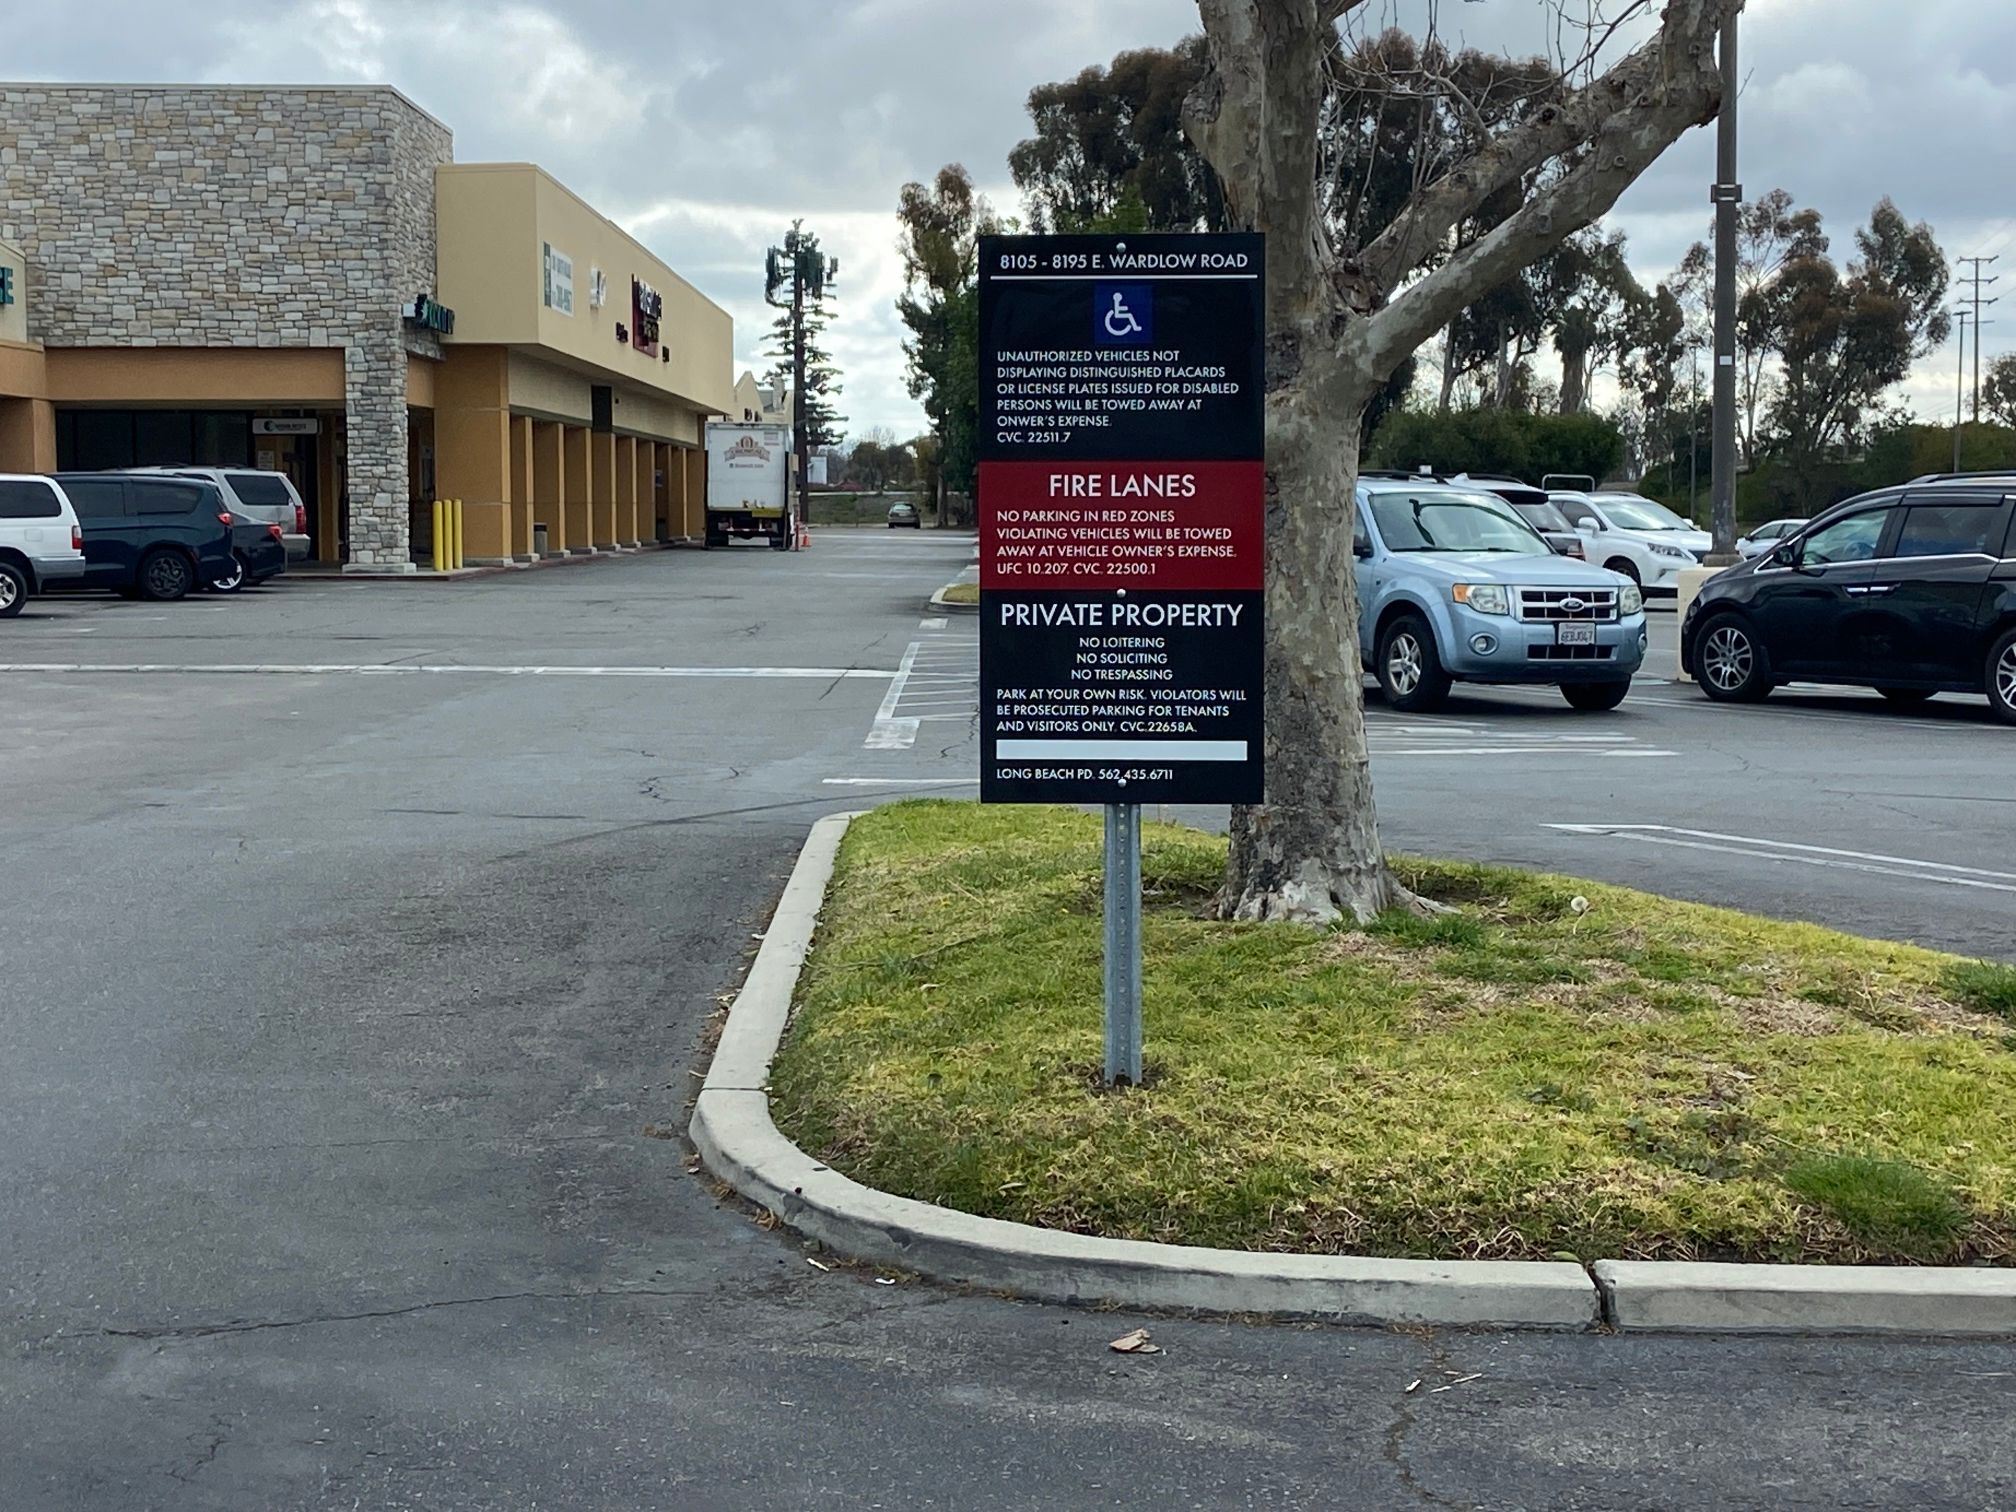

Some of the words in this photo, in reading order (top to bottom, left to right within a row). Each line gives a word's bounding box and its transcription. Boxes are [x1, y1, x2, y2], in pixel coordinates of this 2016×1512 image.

[1000, 254, 1037, 269] 8105
[1052, 254, 1087, 269] 8195
[1092, 254, 1105, 269] E.
[1109, 254, 1197, 268] WARDLOW
[1201, 253, 1248, 268] ROAD
[997, 350, 1092, 362] UNAUTHORIZED
[1095, 350, 1150, 362] VEHICLES
[1153, 350, 1180, 362] NOT
[997, 366, 1067, 378] DISPLAYING
[1070, 366, 1162, 378] DISTINGUISHED
[1164, 366, 1226, 378] PLACARDS
[997, 383, 1015, 394] OR
[1018, 383, 1066, 394] LICENSE
[1068, 383, 1108, 394] PLATES
[1111, 382, 1153, 394] ISSUED
[1156, 383, 1180, 394] FOR
[1182, 382, 1239, 394] DISABLED
[997, 399, 1052, 411] PERSONS
[1054, 399, 1082, 410] WILL
[1085, 399, 1099, 410] BE
[1101, 399, 1146, 410] TOWED
[1148, 399, 1185, 410] AWAY
[1187, 399, 1202, 410] AT
[997, 415, 1055, 427] ONWER'S
[1050, 474, 1102, 497] FIRE
[1110, 474, 1196, 497] LANES
[997, 510, 1020, 522] NO
[1023, 510, 1081, 522] PARKING
[1084, 510, 1098, 522] IN
[1102, 510, 1127, 522] RED
[1130, 510, 1175, 522] ZONES
[996, 527, 1068, 540] VIOLATING
[1070, 527, 1130, 540] VEHICLES
[1132, 528, 1163, 540] WILL
[1166, 528, 1181, 540] BE
[1183, 528, 1232, 540] TOWED
[996, 545, 1036, 557] AWAY
[1038, 545, 1055, 557] AT
[1056, 545, 1109, 557] VEHICLE
[1111, 545, 1175, 557] OWNER'S
[997, 562, 1022, 574] UFC
[1001, 603, 1103, 626] PRIVATE
[1112, 603, 1243, 626] PROPERTY
[1079, 637, 1100, 648] NO
[1102, 637, 1165, 648] LOITERING
[1076, 653, 1098, 664] NO
[1100, 652, 1168, 664] SOLICITING
[1071, 669, 1092, 680] NO
[1094, 669, 1173, 680] TRESPASSING
[996, 688, 1027, 700] PARK
[1029, 688, 1044, 700] AT
[1046, 688, 1080, 700] YOUR
[1082, 688, 1116, 700] OWN
[1150, 689, 1217, 701] VIOLATORS
[1218, 689, 1247, 701] WILL
[996, 704, 1011, 716] BE
[1013, 704, 1090, 716] PROSECUTED
[1092, 705, 1146, 716] PARKING
[1148, 705, 1172, 716] FOR
[1174, 705, 1230, 717] TENANTS
[996, 720, 1024, 732] AND
[1026, 720, 1079, 732] VISITORS
[996, 768, 1032, 779] LONG
[1035, 768, 1074, 780] BEACH
